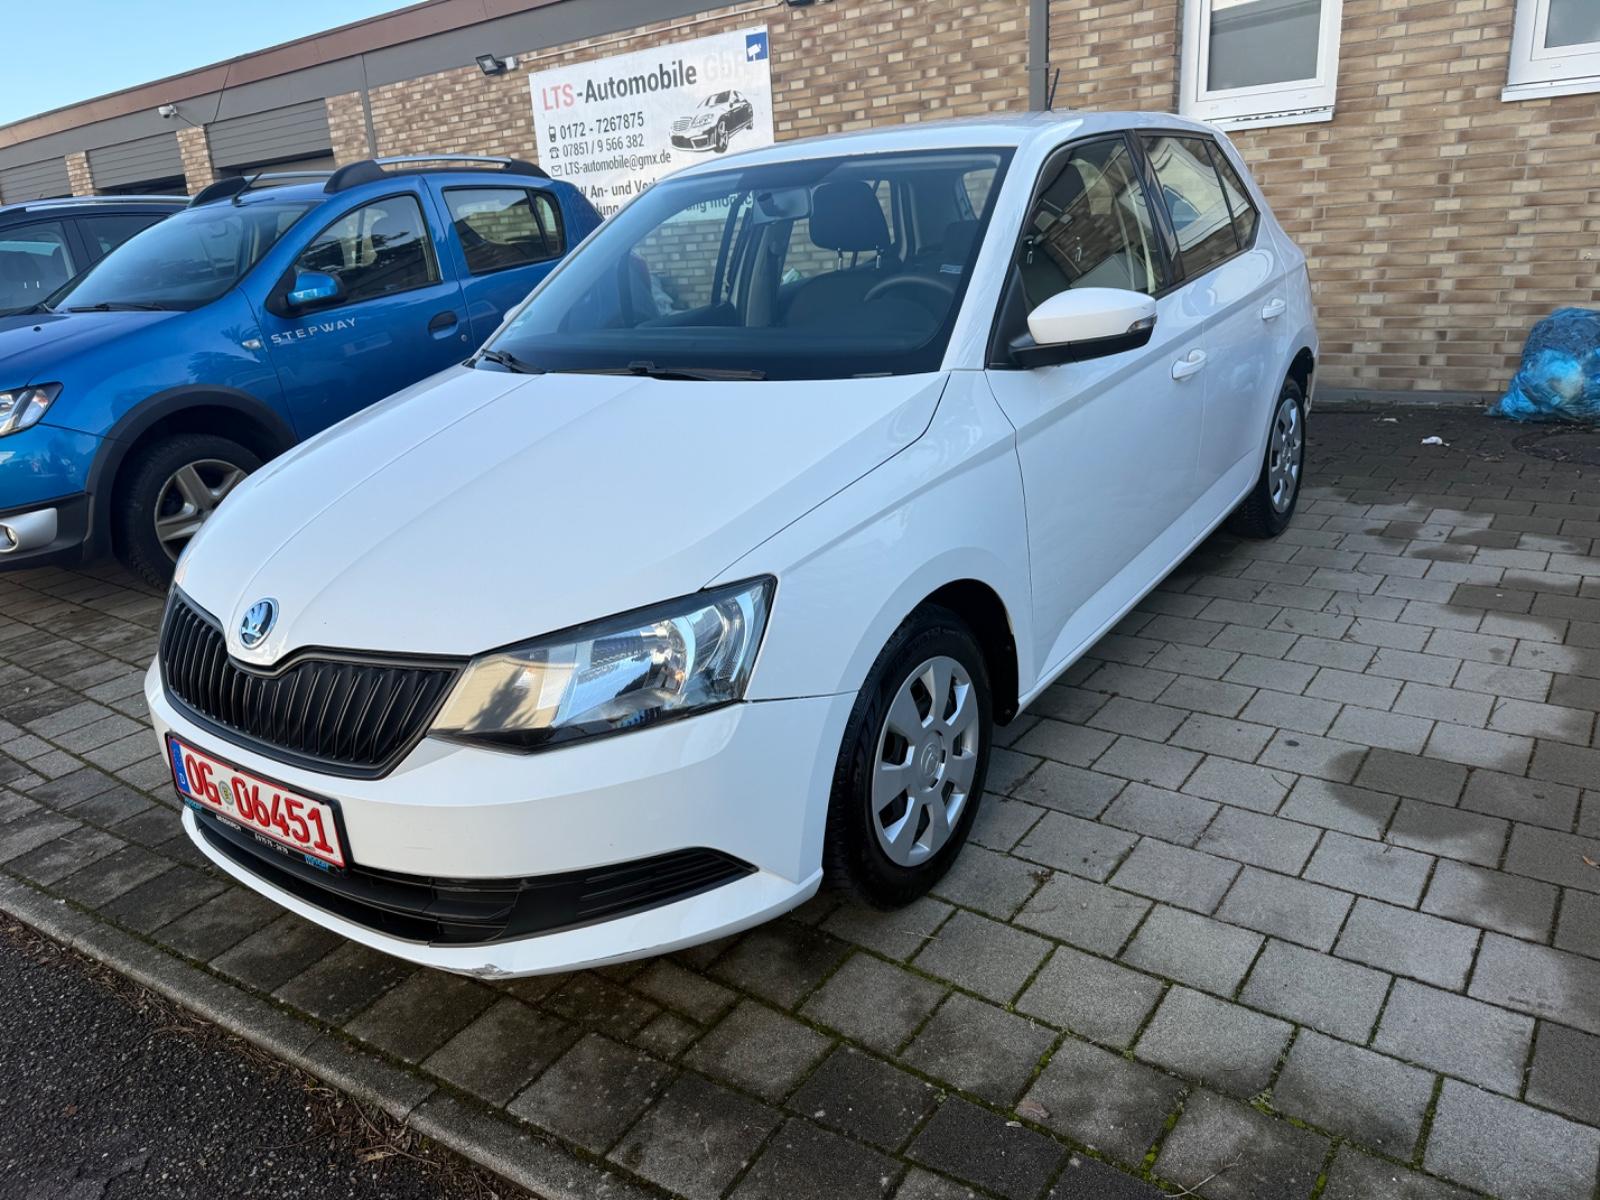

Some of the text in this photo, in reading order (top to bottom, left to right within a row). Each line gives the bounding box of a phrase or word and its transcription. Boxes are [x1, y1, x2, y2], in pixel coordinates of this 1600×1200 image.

[560, 122, 586, 140] 0172
[595, 111, 644, 134] 7267875
[562, 141, 589, 157] 07851
[605, 136, 624, 151] 566
[626, 133, 645, 149] 382
[564, 149, 671, 176] LTS-automobile@gmx.de
[590, 182, 608, 198] An-
[611, 179, 632, 196] und
[270, 317, 356, 344] STEPWAY
[185, 753, 222, 805] OG
[231, 776, 333, 854] 06451
